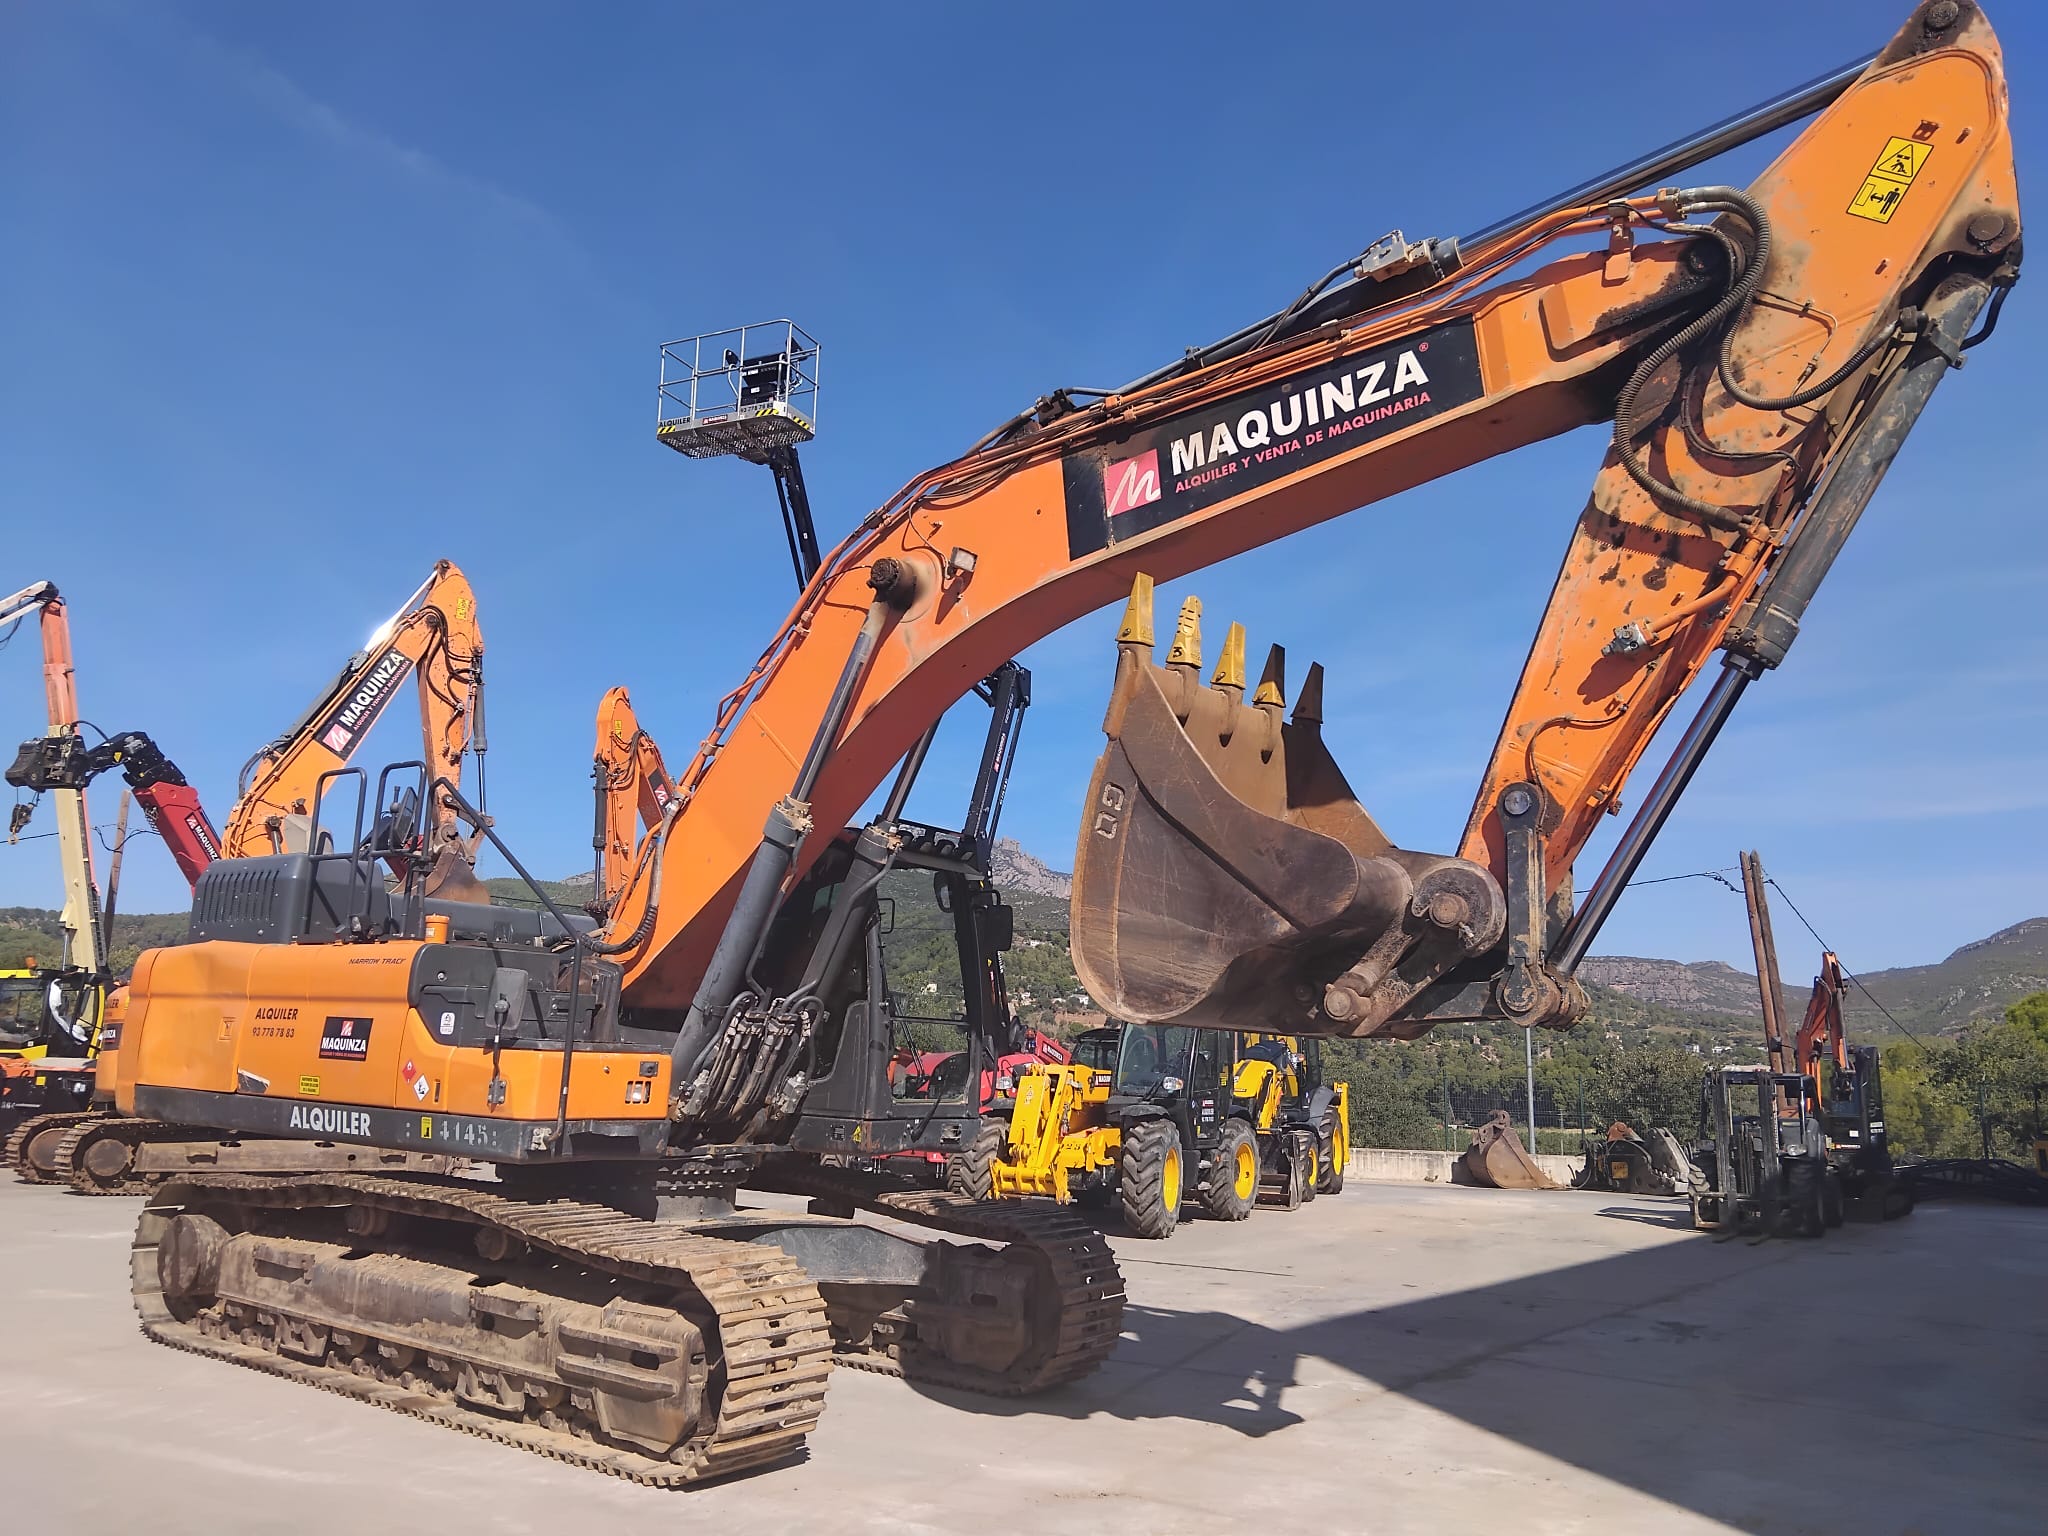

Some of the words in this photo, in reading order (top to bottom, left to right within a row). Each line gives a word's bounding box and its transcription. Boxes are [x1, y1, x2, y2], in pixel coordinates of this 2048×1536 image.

[659, 417, 691, 427] ALQUILER
[1175, 462, 1238, 494] ALQUILER
[1241, 456, 1251, 469] Y
[1254, 441, 1301, 463] VENTA
[1306, 430, 1324, 446] DE
[1328, 391, 1431, 437] MAQUINARIA
[339, 652, 404, 727] MAQUINZA
[255, 1007, 299, 1021] ALQUILER
[252, 1026, 261, 1037] 93
[261, 1027, 275, 1038] 778
[286, 1028, 295, 1039] 83
[321, 1037, 366, 1052] MAQUINZA
[290, 1106, 372, 1137] ALQUILER
